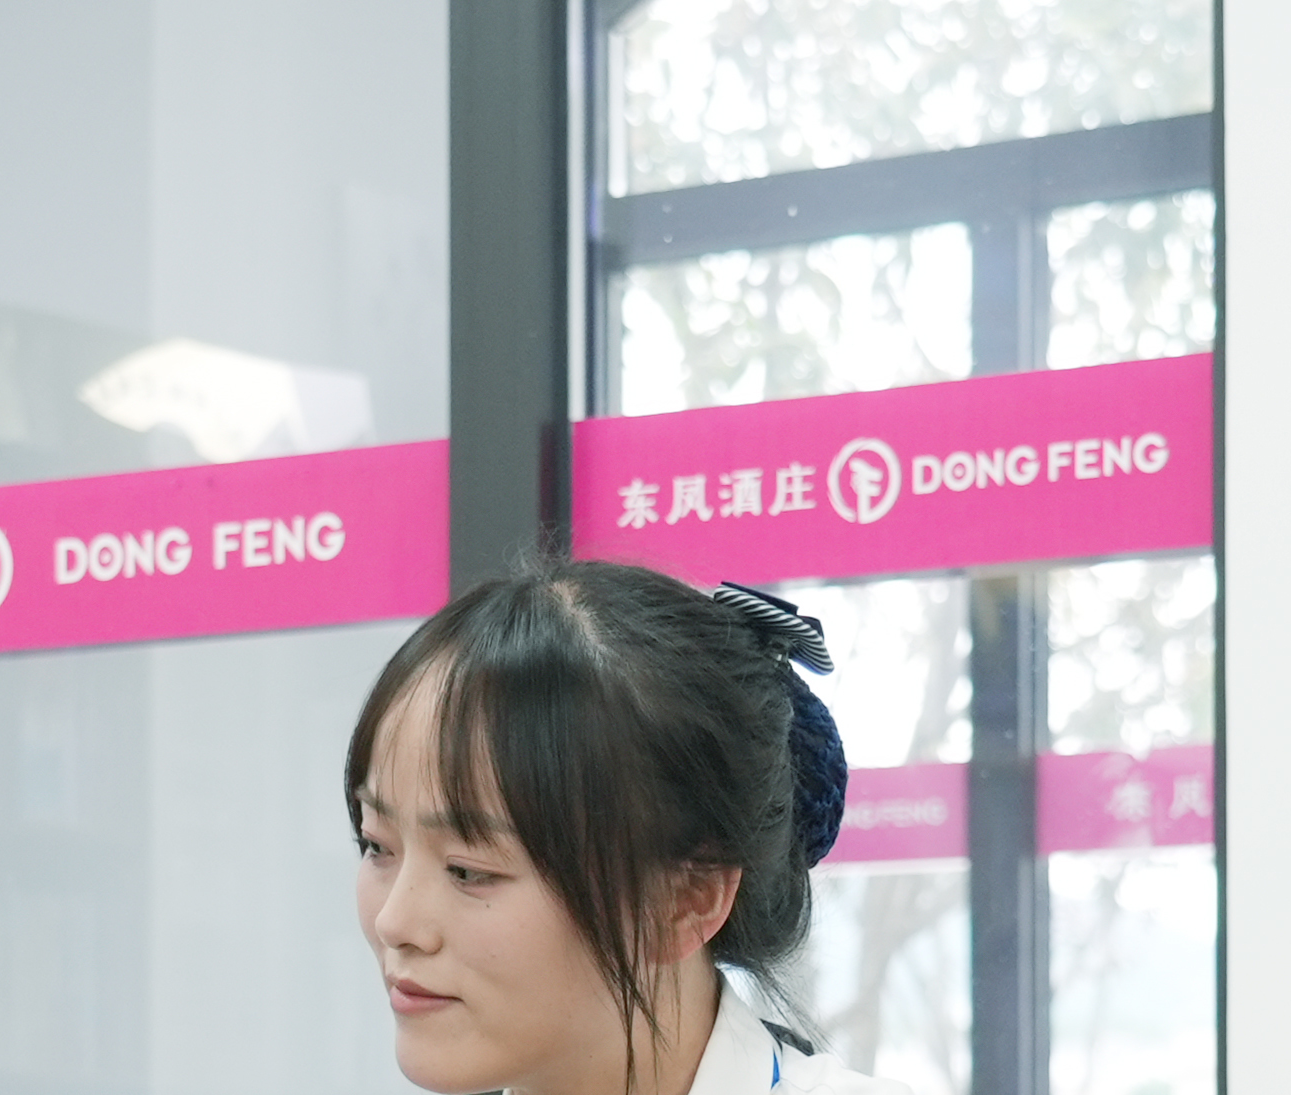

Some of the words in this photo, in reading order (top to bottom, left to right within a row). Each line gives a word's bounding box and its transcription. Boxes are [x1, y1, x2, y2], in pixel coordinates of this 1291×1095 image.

[911, 444, 1041, 495] DONG
[1046, 431, 1171, 482] FENG
[53, 526, 193, 585] DONG
[212, 510, 347, 570] FENG
